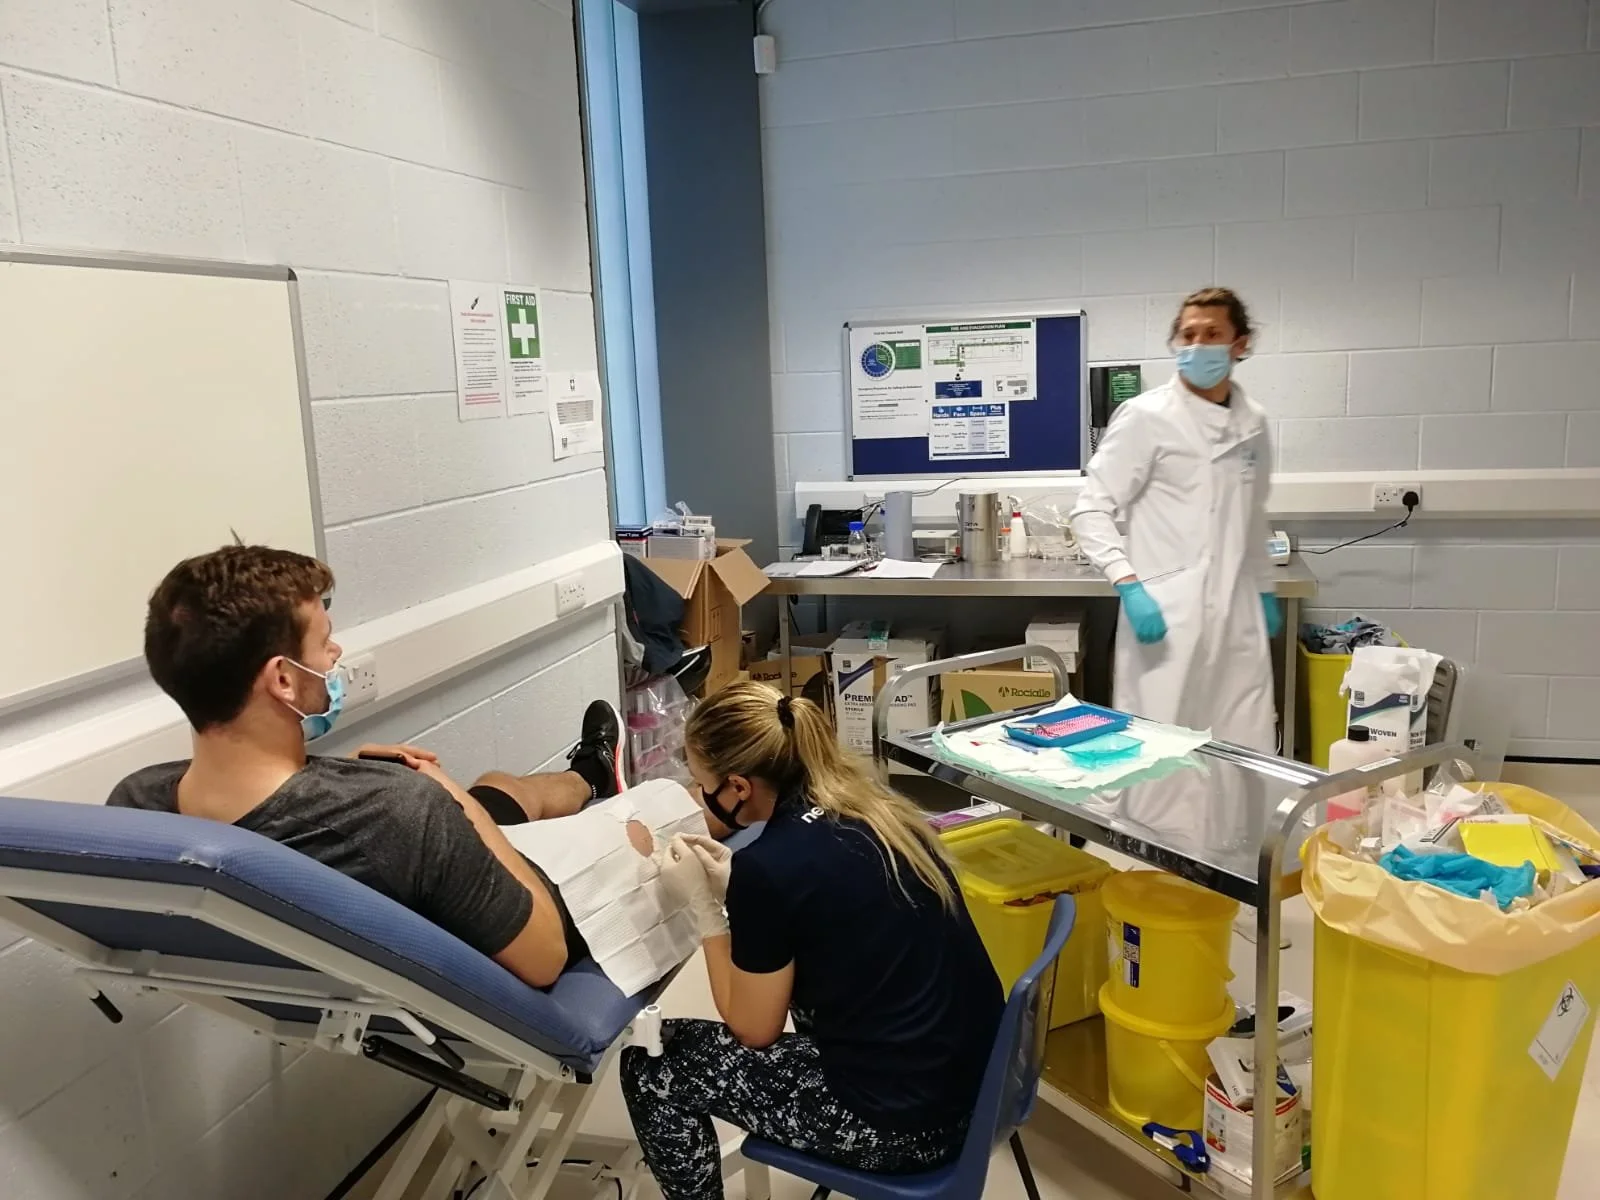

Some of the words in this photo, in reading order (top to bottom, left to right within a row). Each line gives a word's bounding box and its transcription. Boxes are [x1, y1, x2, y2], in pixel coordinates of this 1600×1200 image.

[506, 294, 524, 305] FIRST
[525, 295, 536, 306] AID
[1011, 688, 1051, 697] Rocialle
[1370, 728, 1397, 737] WOVEN
